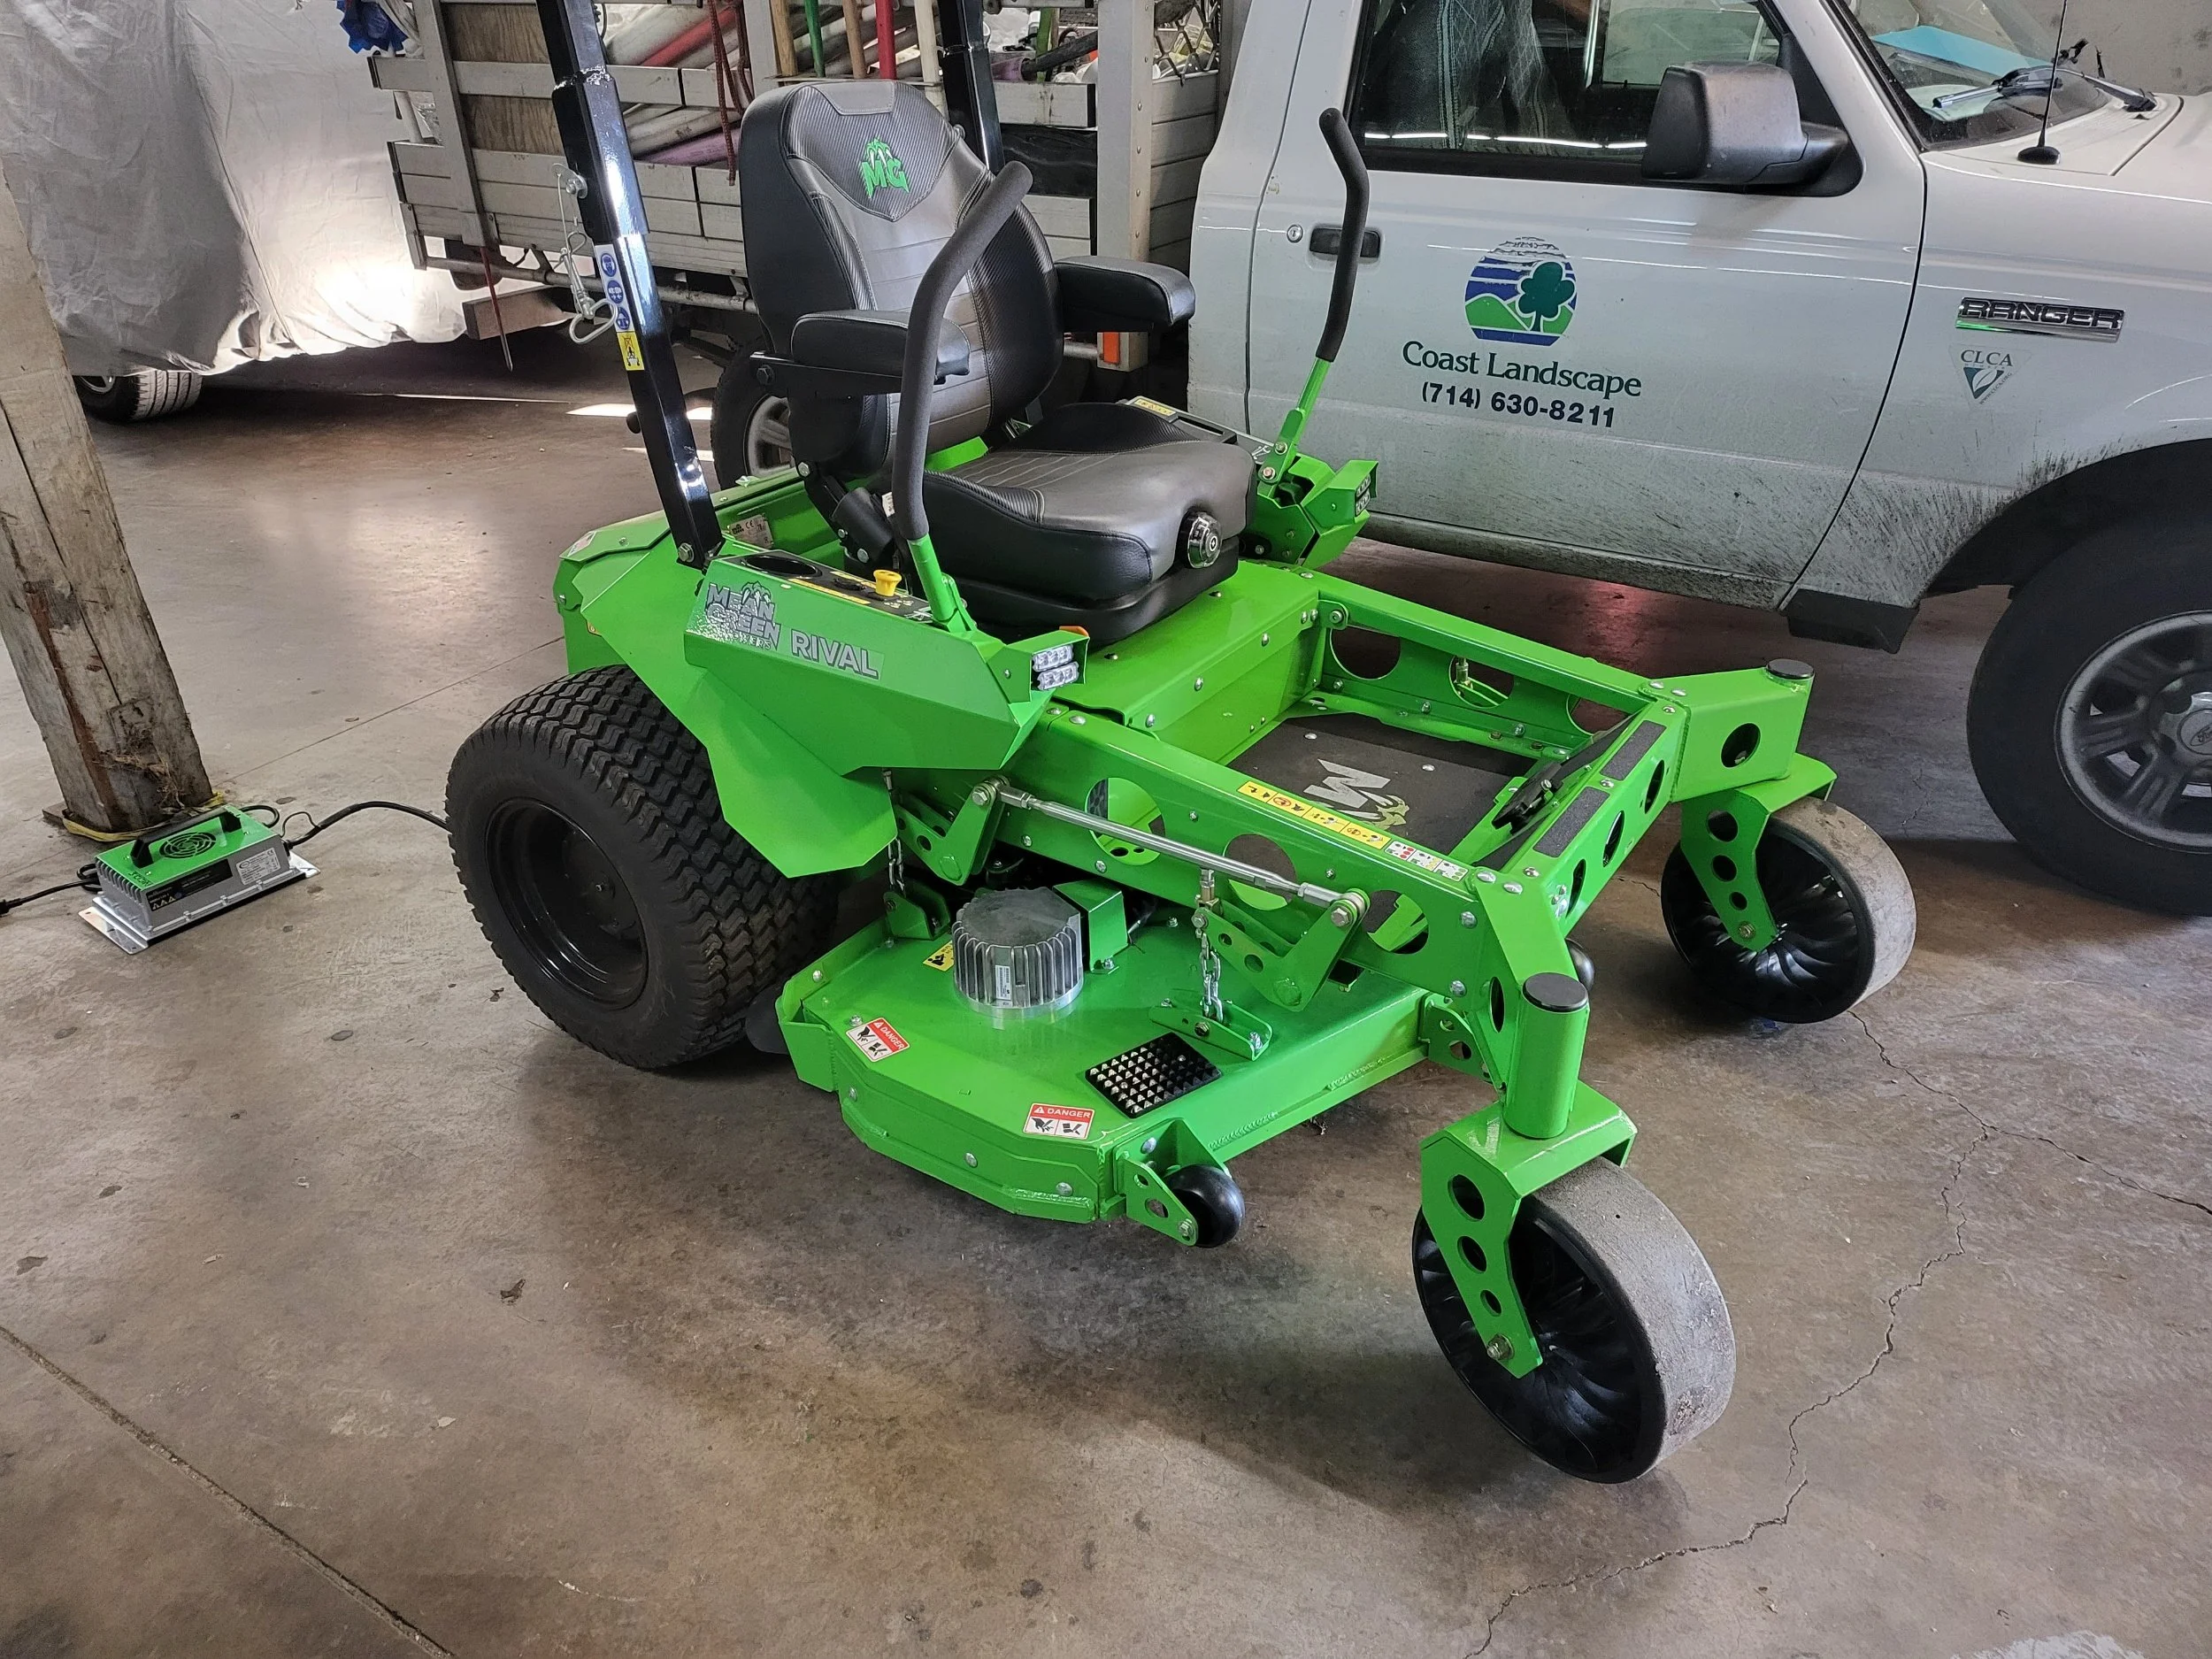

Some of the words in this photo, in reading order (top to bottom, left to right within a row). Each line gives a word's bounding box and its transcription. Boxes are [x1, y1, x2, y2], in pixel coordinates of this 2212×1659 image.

[860, 157, 910, 199] MG
[1960, 296, 2124, 330] RANGER
[1402, 341, 1480, 374] Coast
[1486, 352, 1642, 400] Landscape
[1961, 349, 2013, 366] CLCA
[1422, 381, 1481, 409] (714)
[1491, 391, 1615, 427] 630-8211
[705, 582, 775, 621] MEAN
[705, 603, 781, 650] GREEN
[791, 629, 879, 680] RIVAL
[879, 1025, 905, 1050] DANGER
[1047, 1108, 1092, 1118] DANGER
